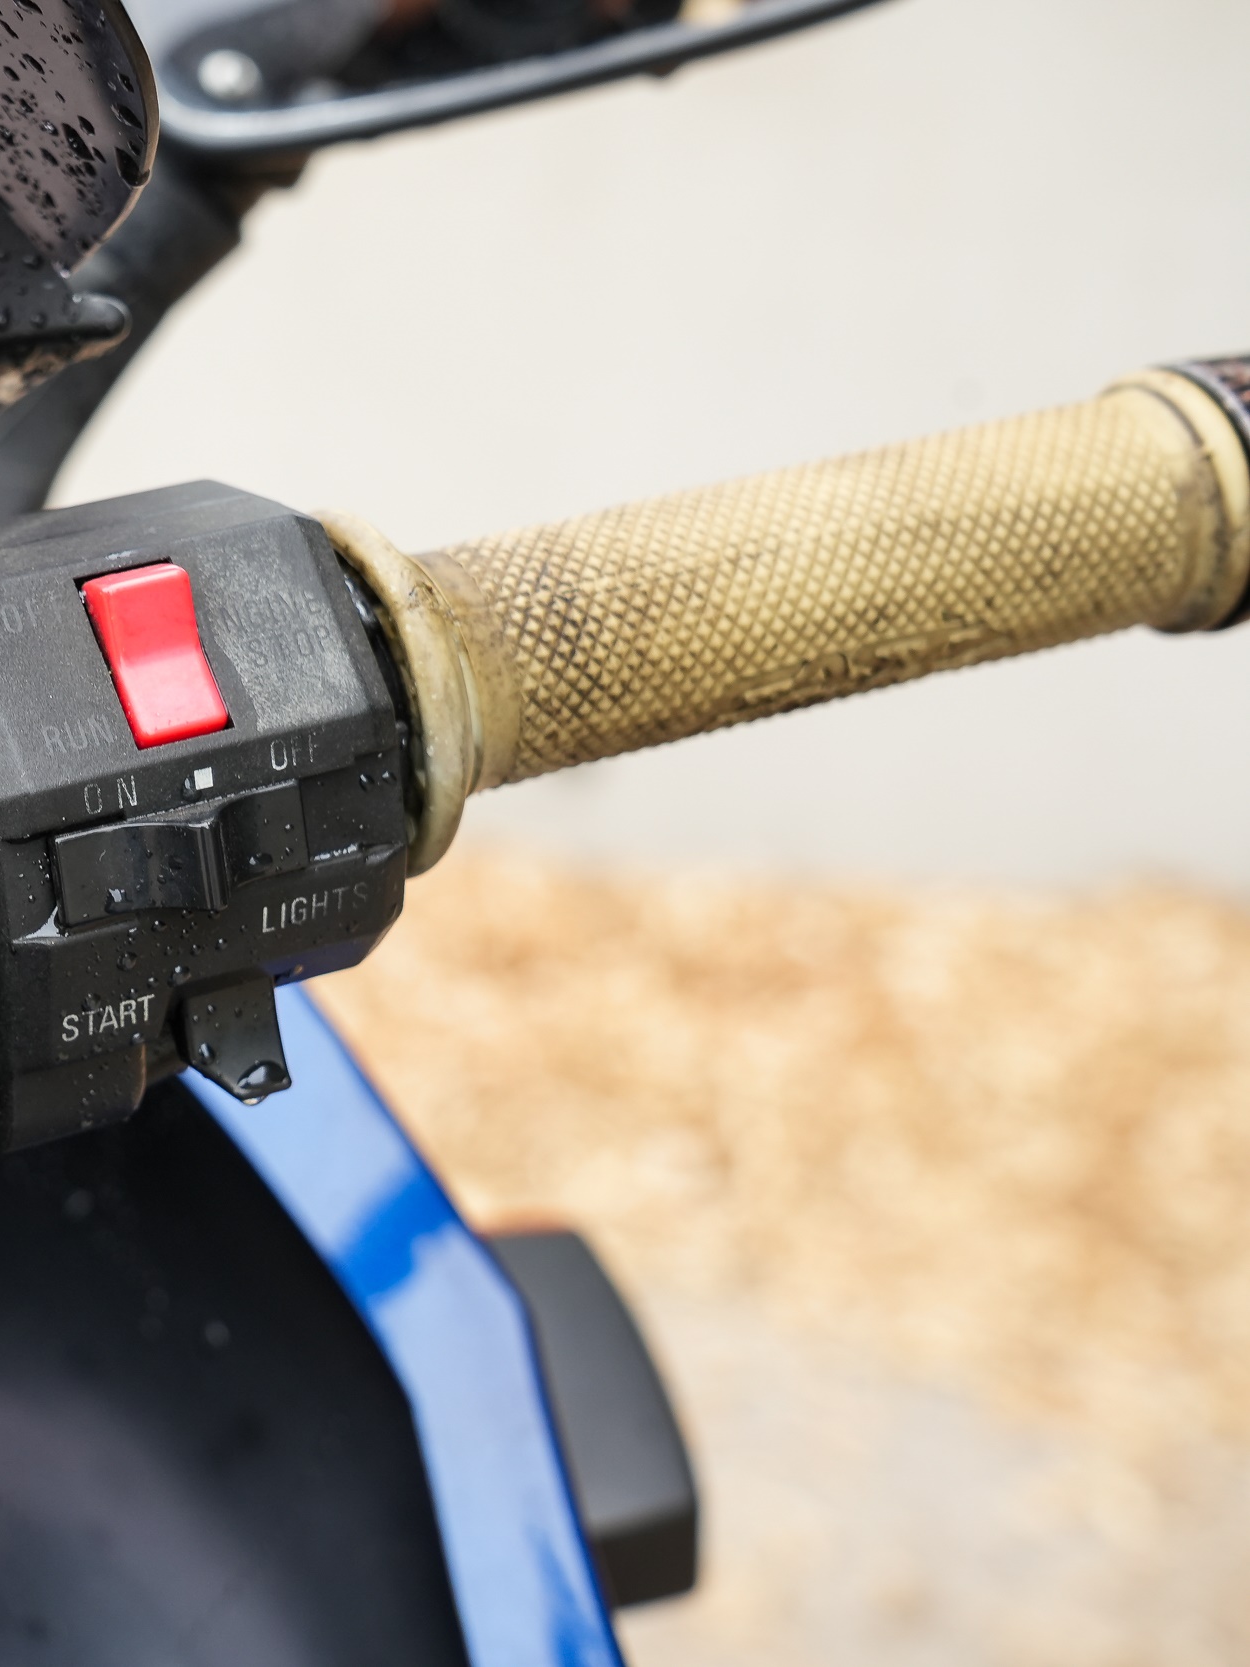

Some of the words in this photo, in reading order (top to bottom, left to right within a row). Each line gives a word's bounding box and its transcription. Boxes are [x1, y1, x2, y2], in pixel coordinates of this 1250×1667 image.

[249, 624, 331, 667] STOP
[42, 713, 115, 755] RUN
[269, 733, 320, 771] OFF
[83, 775, 138, 815] ON
[261, 881, 369, 933] LIGHTS
[61, 994, 155, 1042] START
